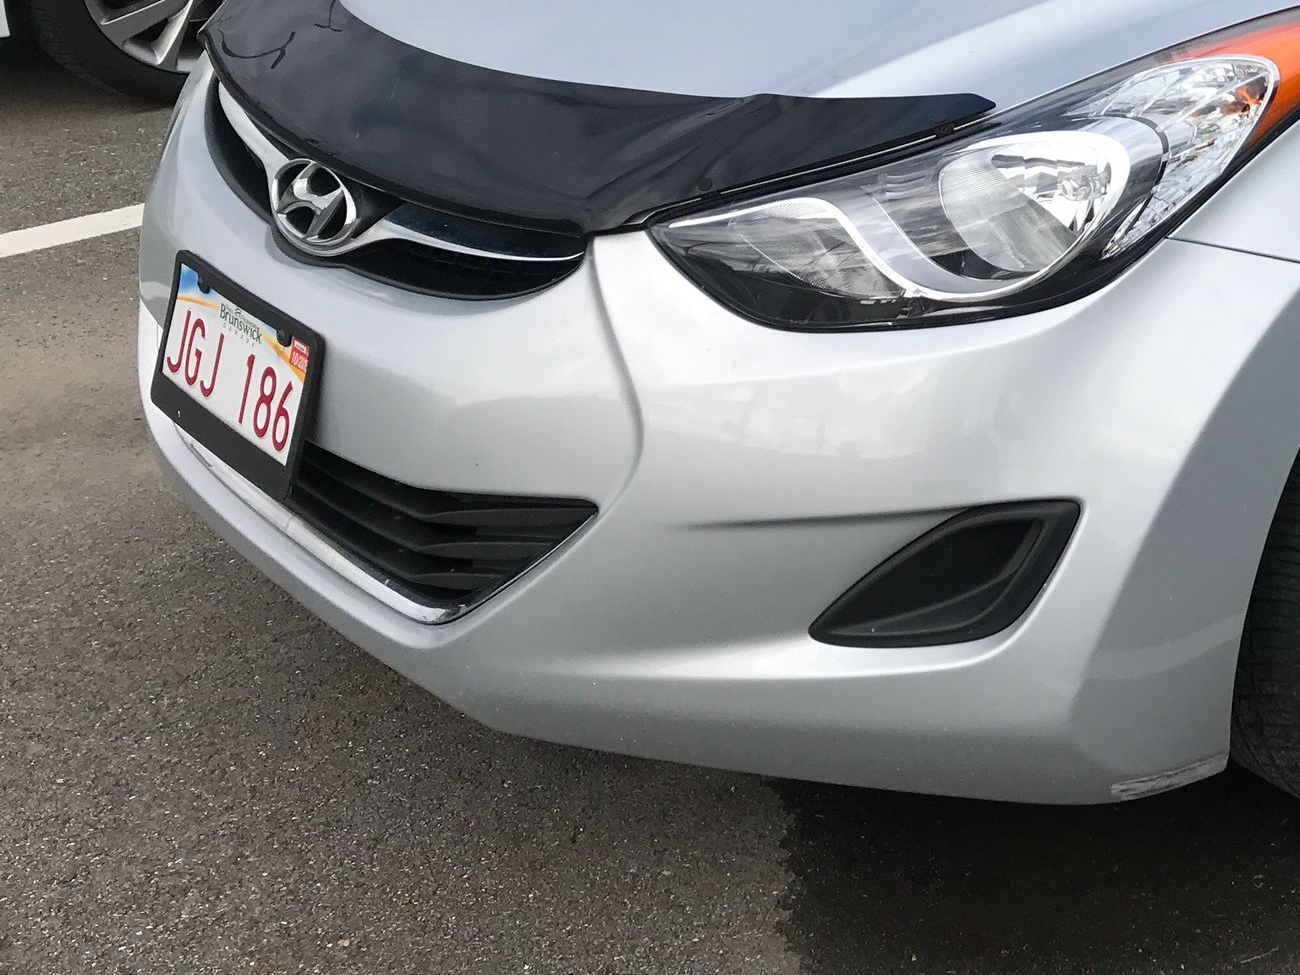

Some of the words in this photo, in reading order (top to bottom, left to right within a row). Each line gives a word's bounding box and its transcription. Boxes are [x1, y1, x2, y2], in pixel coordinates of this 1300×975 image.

[219, 303, 262, 344] Brunswick
[166, 309, 225, 398] JGJ
[238, 353, 294, 452] 186
